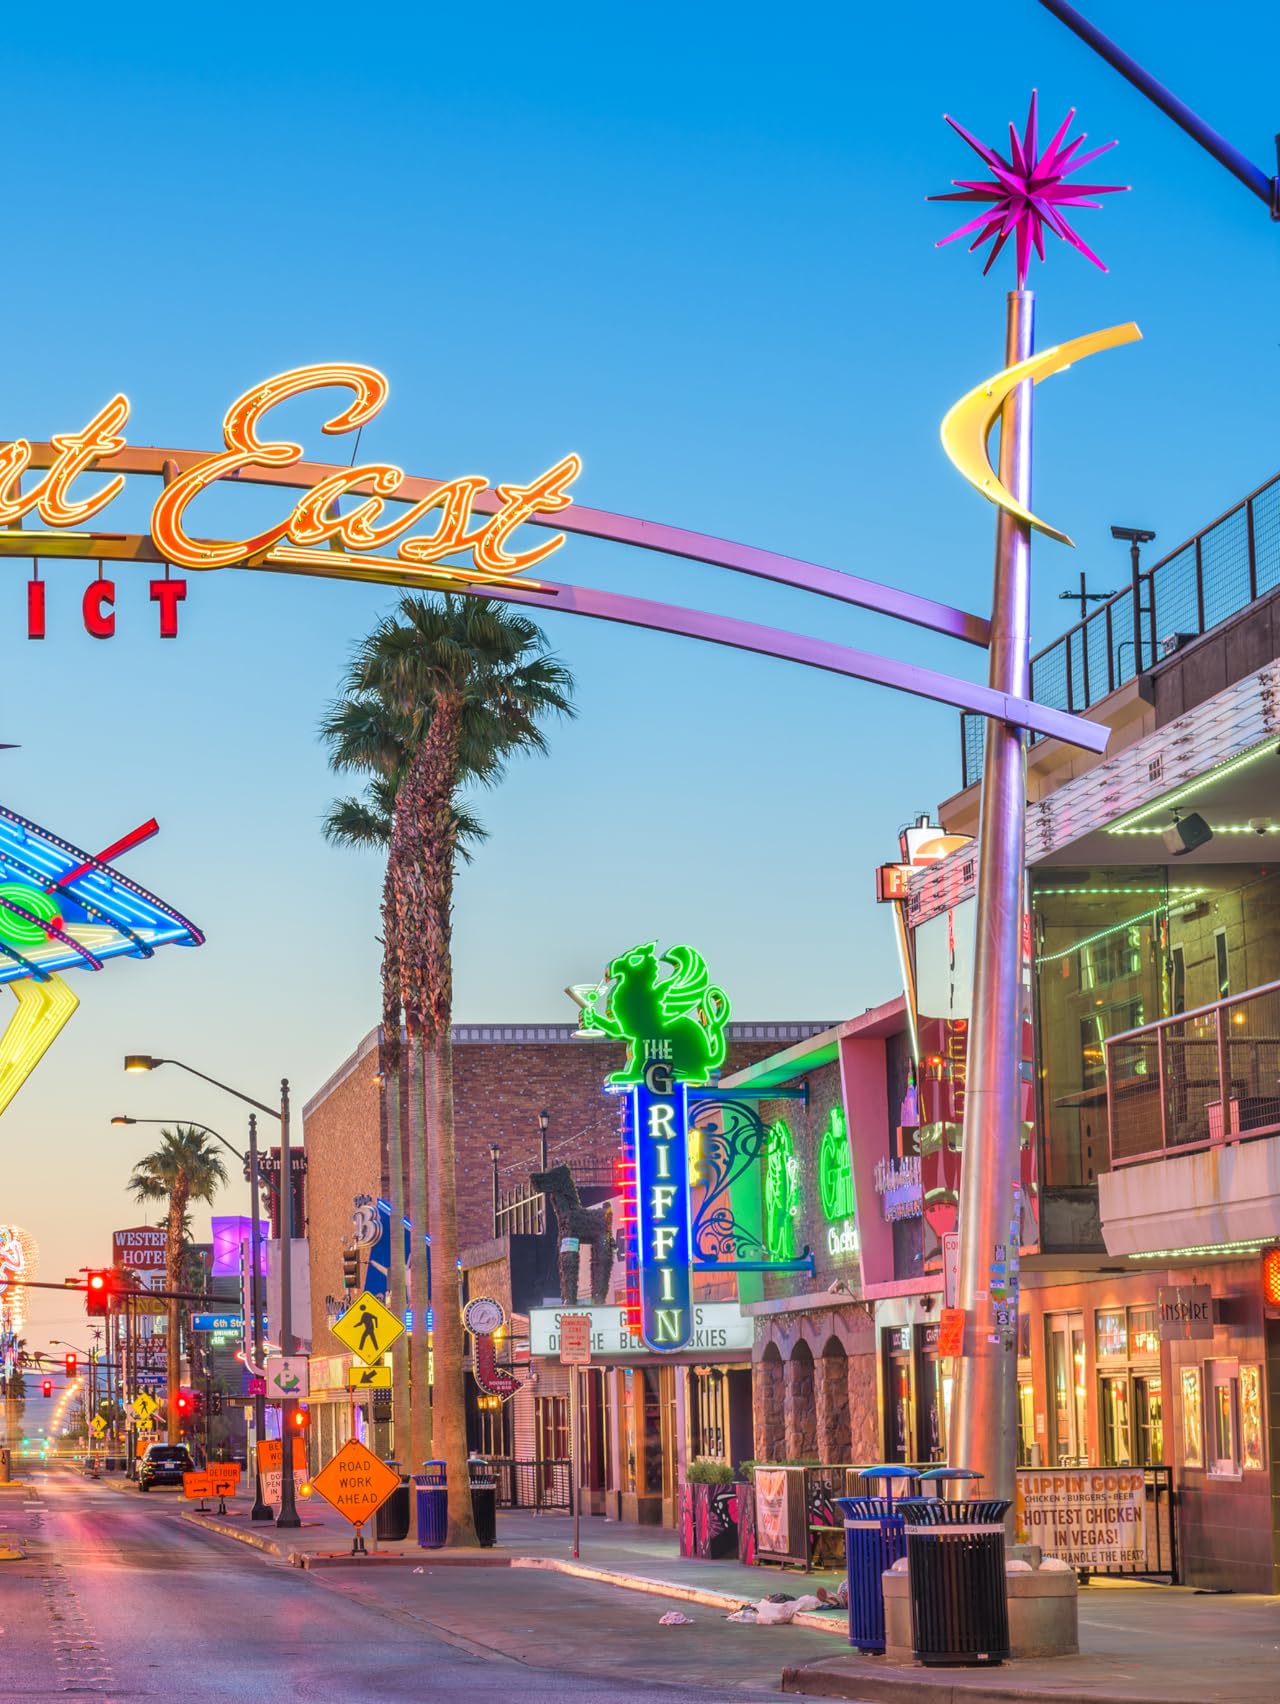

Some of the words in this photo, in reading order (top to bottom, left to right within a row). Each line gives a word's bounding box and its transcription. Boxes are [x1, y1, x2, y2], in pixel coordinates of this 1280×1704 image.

[150, 361, 584, 575] East
[642, 1039, 673, 1060] THE
[643, 1062, 681, 1343] GRIFFIN
[115, 1231, 168, 1246] WESTER
[1161, 1300, 1209, 1320] INSPIRE
[213, 1319, 227, 1328] 6th
[230, 1318, 255, 1328] Strt
[209, 1469, 238, 1477] DETOUR
[339, 1461, 371, 1472] ROAD
[339, 1476, 372, 1488] WORK
[1091, 1474, 1143, 1492] GOOD
[336, 1493, 378, 1505] AHEAD
[1024, 1494, 1061, 1503] CHICKEN
[1067, 1493, 1107, 1502] BURGERS
[1113, 1492, 1134, 1501] BEER
[1024, 1509, 1082, 1526] HOTTEST
[1085, 1507, 1142, 1524] CHICKEN
[1054, 1531, 1067, 1546] IN
[1072, 1529, 1119, 1546] VEGAS!
[1061, 1552, 1097, 1564] HANDLE
[1099, 1551, 1117, 1562] THE
[1121, 1550, 1144, 1561] HEAT?
